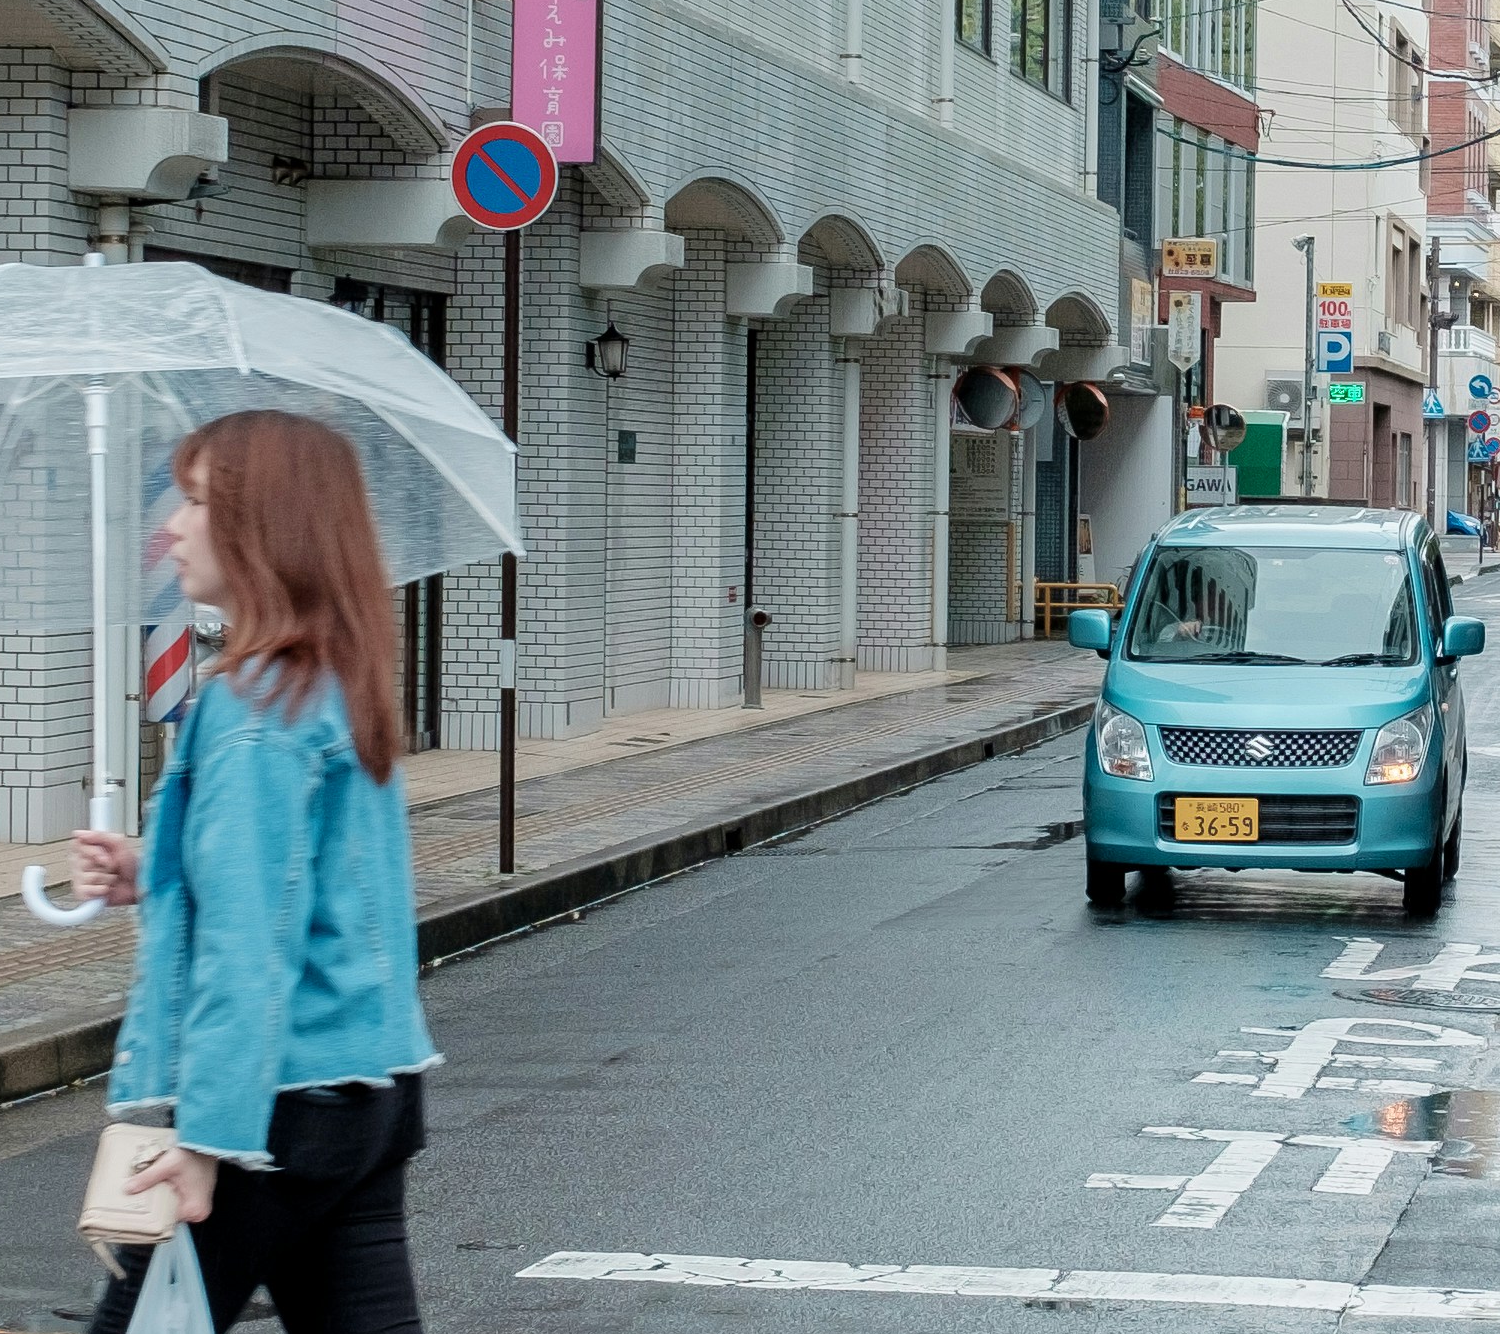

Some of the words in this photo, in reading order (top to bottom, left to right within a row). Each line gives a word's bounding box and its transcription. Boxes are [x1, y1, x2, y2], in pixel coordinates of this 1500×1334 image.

[1319, 333, 1350, 371] P
[1329, 384, 1364, 403] 空車
[1194, 816, 1253, 837] 36-59
